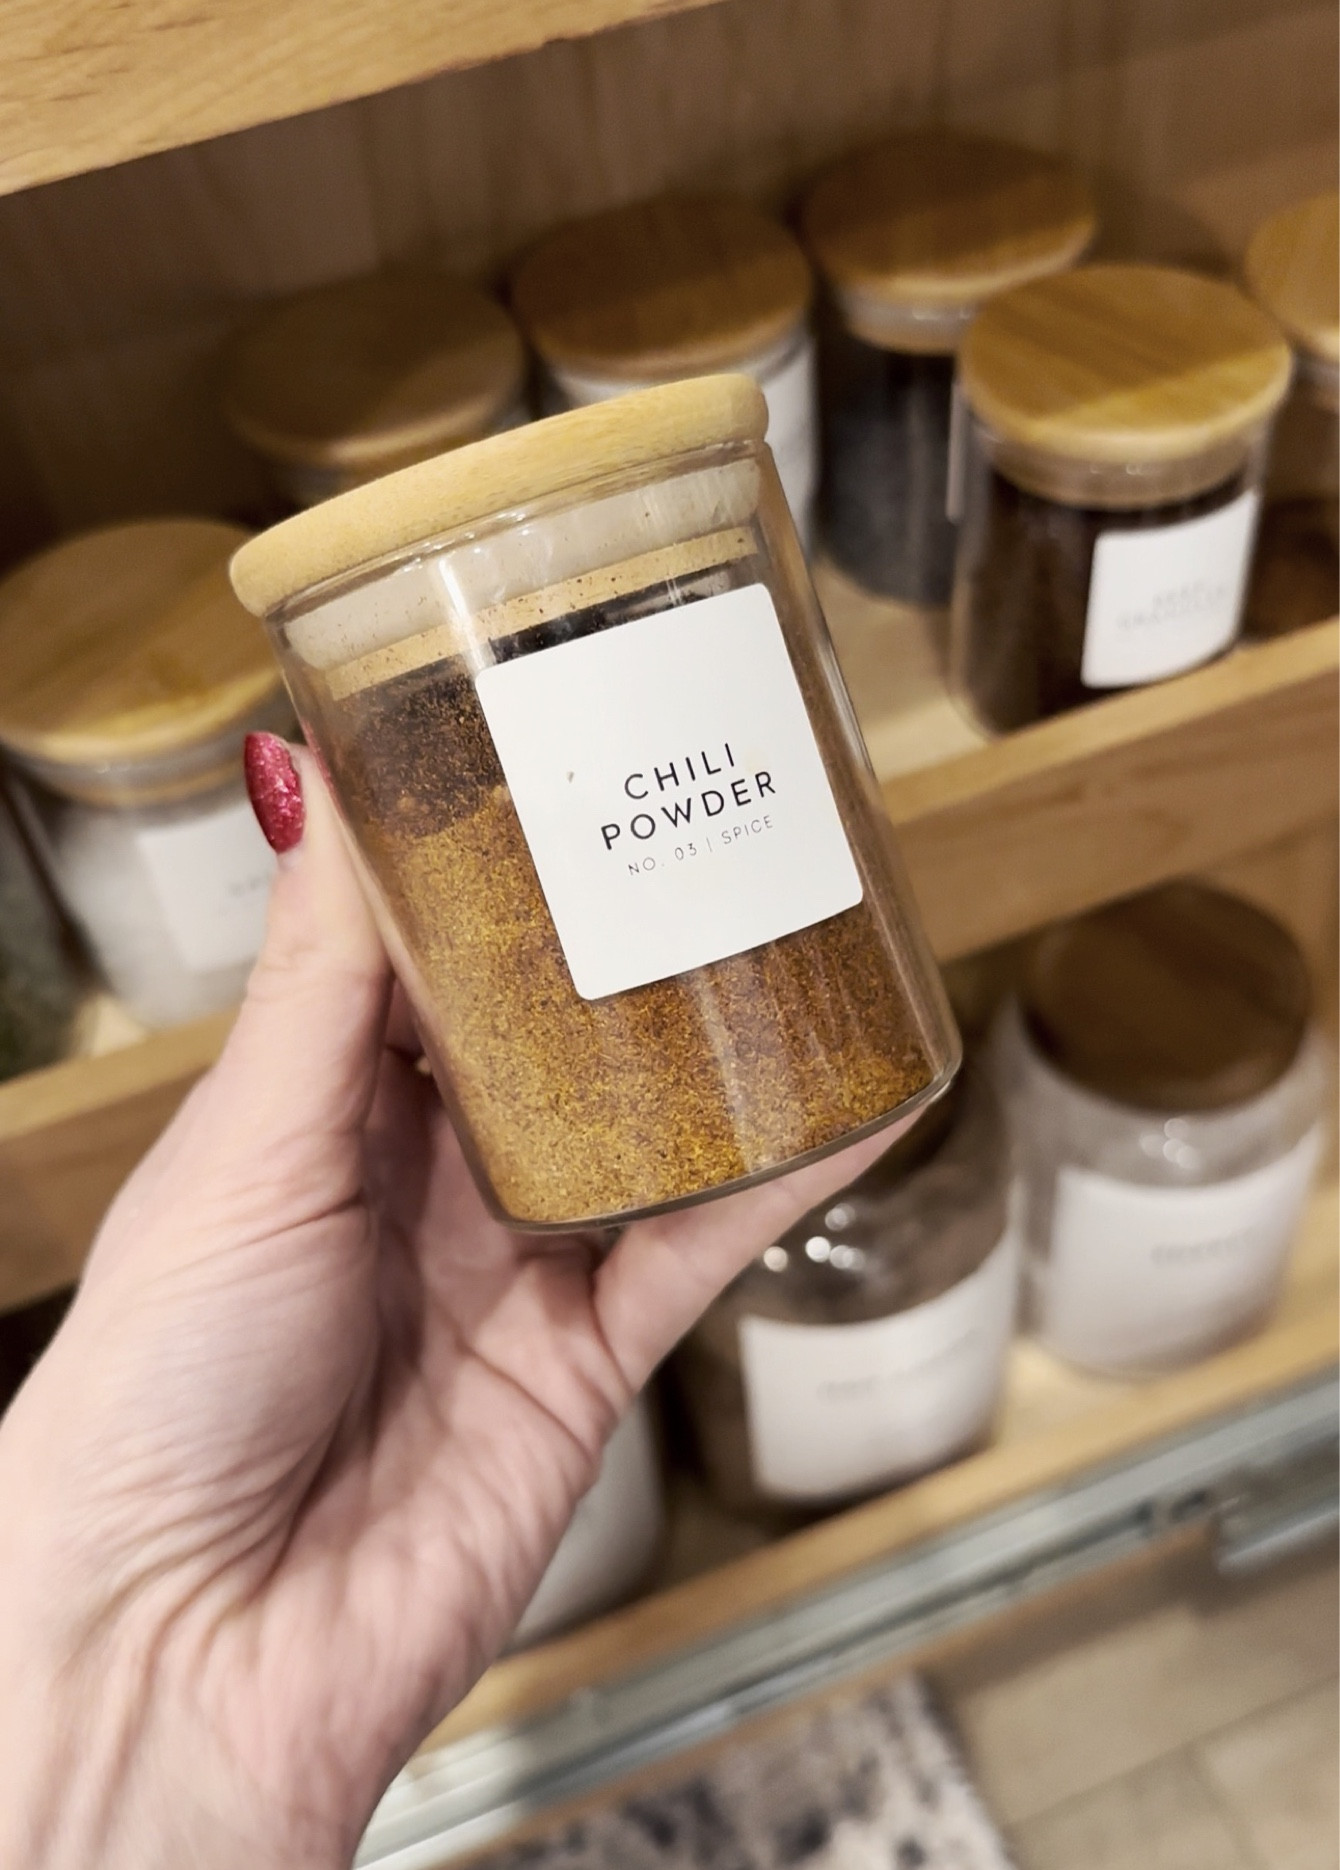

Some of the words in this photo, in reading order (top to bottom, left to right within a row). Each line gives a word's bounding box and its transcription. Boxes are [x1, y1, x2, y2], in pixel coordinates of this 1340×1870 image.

[624, 743, 735, 800] CHILI
[601, 771, 777, 851] POWDER
[628, 857, 665, 876] NO.
[674, 842, 698, 861] 03
[721, 815, 775, 845] SPICE
